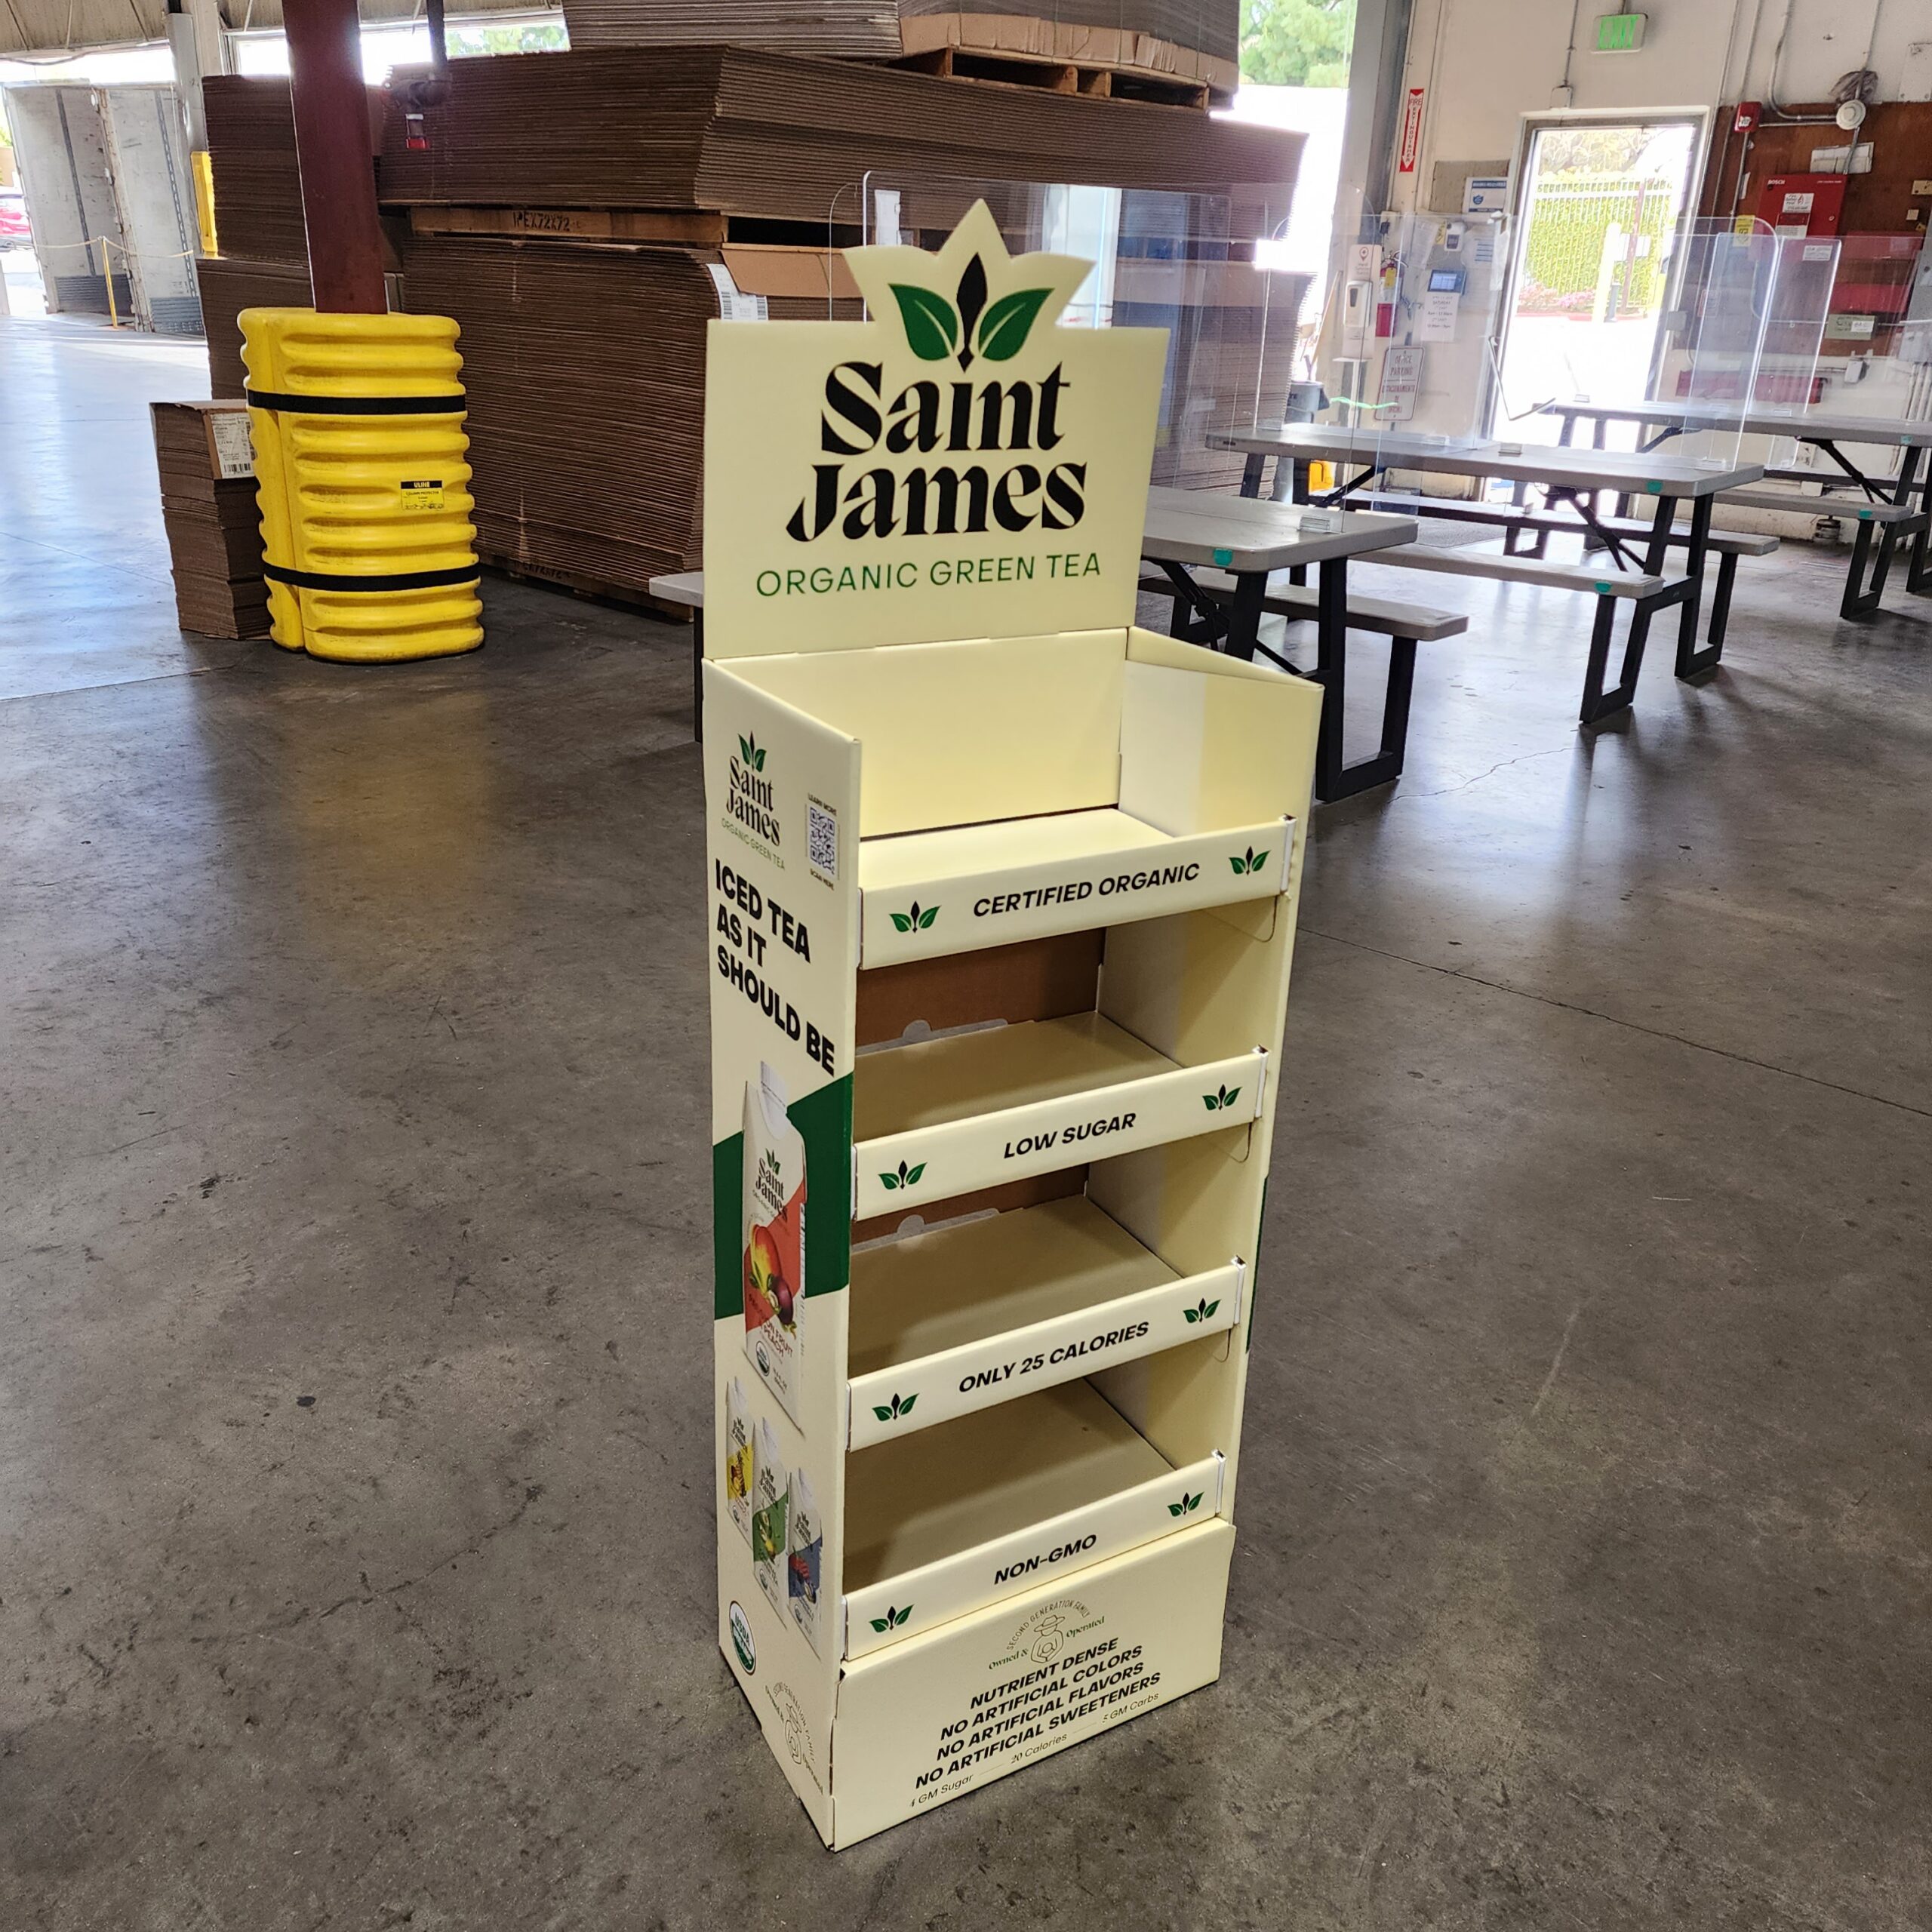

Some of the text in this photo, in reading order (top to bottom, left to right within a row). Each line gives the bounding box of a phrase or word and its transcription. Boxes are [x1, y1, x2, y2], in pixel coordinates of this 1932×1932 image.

[821, 361, 1071, 456] Saint
[786, 462, 1087, 542] James
[756, 553, 1102, 596] ORGANIC GREEN TEA
[729, 755, 774, 812] Saint
[721, 817, 785, 871] ORGANIC GREEN TEA
[726, 788, 780, 847] James
[715, 858, 811, 964] ICED TEA
[974, 863, 1200, 917] CERTIFIED ORGANIC
[717, 903, 767, 967] AS IT
[718, 944, 834, 1078] SHOULD BE
[1004, 1112, 1137, 1158] LOW SUGAR
[755, 1175, 787, 1223] James
[758, 1157, 784, 1201] Saint
[959, 1321, 1149, 1392] ONLY 25 CALORIES
[994, 1534, 1097, 1585] NON-GMO
[735, 1612, 750, 1647] USDA
[989, 1651, 1020, 1670] Owned
[1066, 1616, 1105, 1638] Operated
[1006, 1599, 1091, 1651] SECOND GENERATION FAMILY
[940, 1645, 1143, 1741] NO ARTIFICIAL COLORS
[970, 1638, 1118, 1709] NUTRIENT DENSE
[915, 1672, 1161, 1789] NO ARTIFICIAL SWEETENERS
[937, 1662, 1145, 1761] NO ARTIFICIAL FLAVORS
[1110, 1706, 1128, 1719] GM
[1130, 1693, 1159, 1710] Carbs
[1025, 1734, 1068, 1758] Calories
[918, 1789, 939, 1804] GM
[940, 1774, 974, 1794] Sugar
